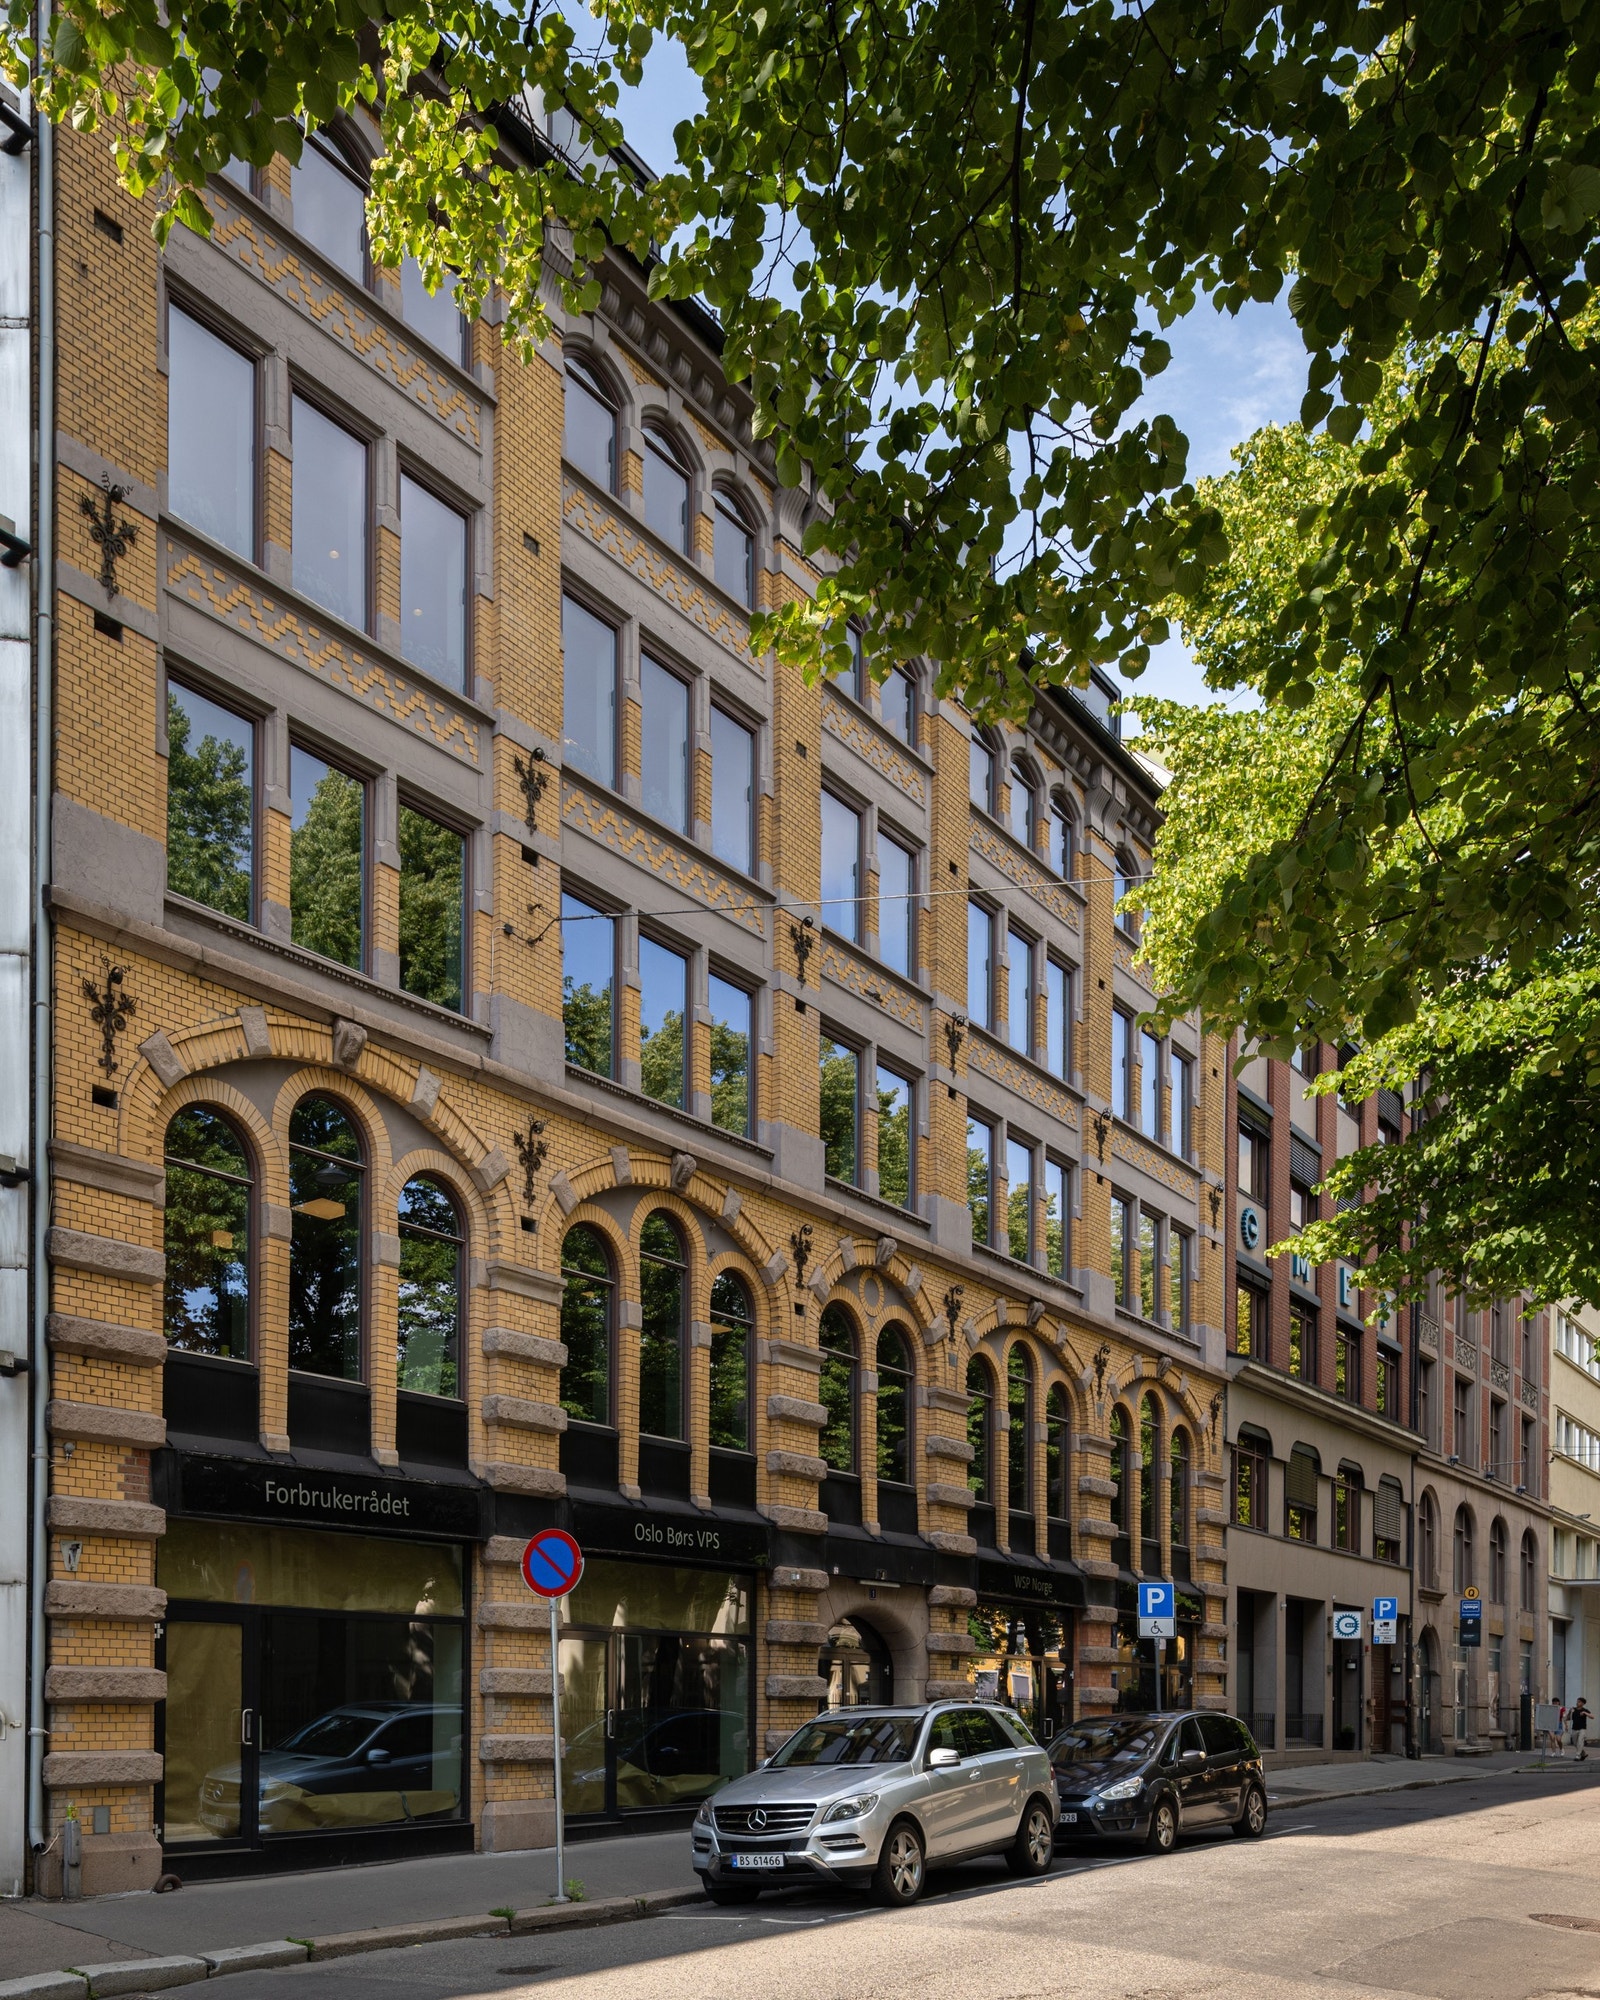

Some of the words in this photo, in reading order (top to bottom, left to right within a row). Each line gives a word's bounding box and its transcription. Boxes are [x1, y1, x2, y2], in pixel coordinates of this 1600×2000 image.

[265, 1480, 410, 1516] Forbrukerrådet
[634, 1523, 663, 1543] Oslo
[667, 1526, 694, 1547] Børs
[696, 1530, 720, 1549] VPS
[1014, 1574, 1031, 1590] WSP
[1032, 1577, 1053, 1596] Norge
[1147, 1587, 1165, 1614] P
[1379, 1600, 1392, 1617] P
[739, 1855, 751, 1866] BS
[753, 1855, 781, 1866] 61466
